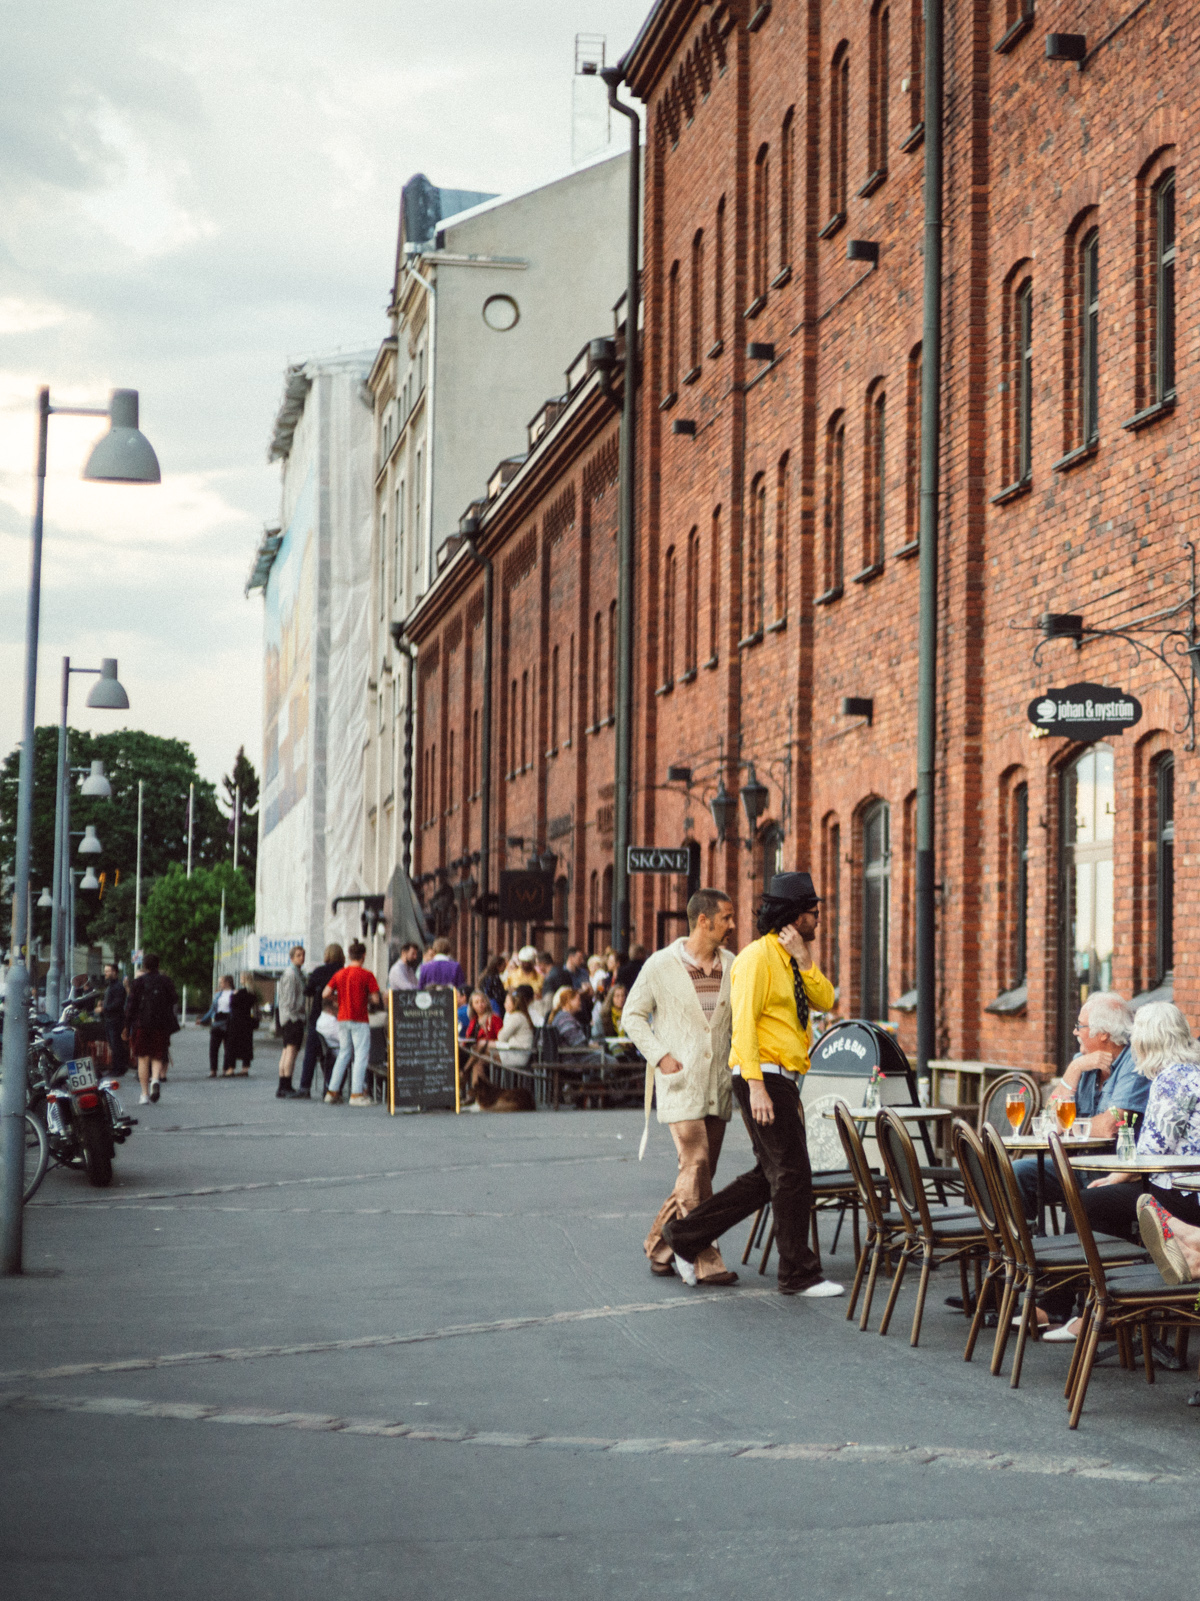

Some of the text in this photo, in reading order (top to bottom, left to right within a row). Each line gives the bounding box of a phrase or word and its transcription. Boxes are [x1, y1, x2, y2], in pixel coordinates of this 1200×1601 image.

[1057, 699, 1134, 721] johan & nyström
[822, 1036, 867, 1059] CAFÉ & BAR
[76, 1061, 91, 1074] PW
[71, 1073, 93, 1088] 601
